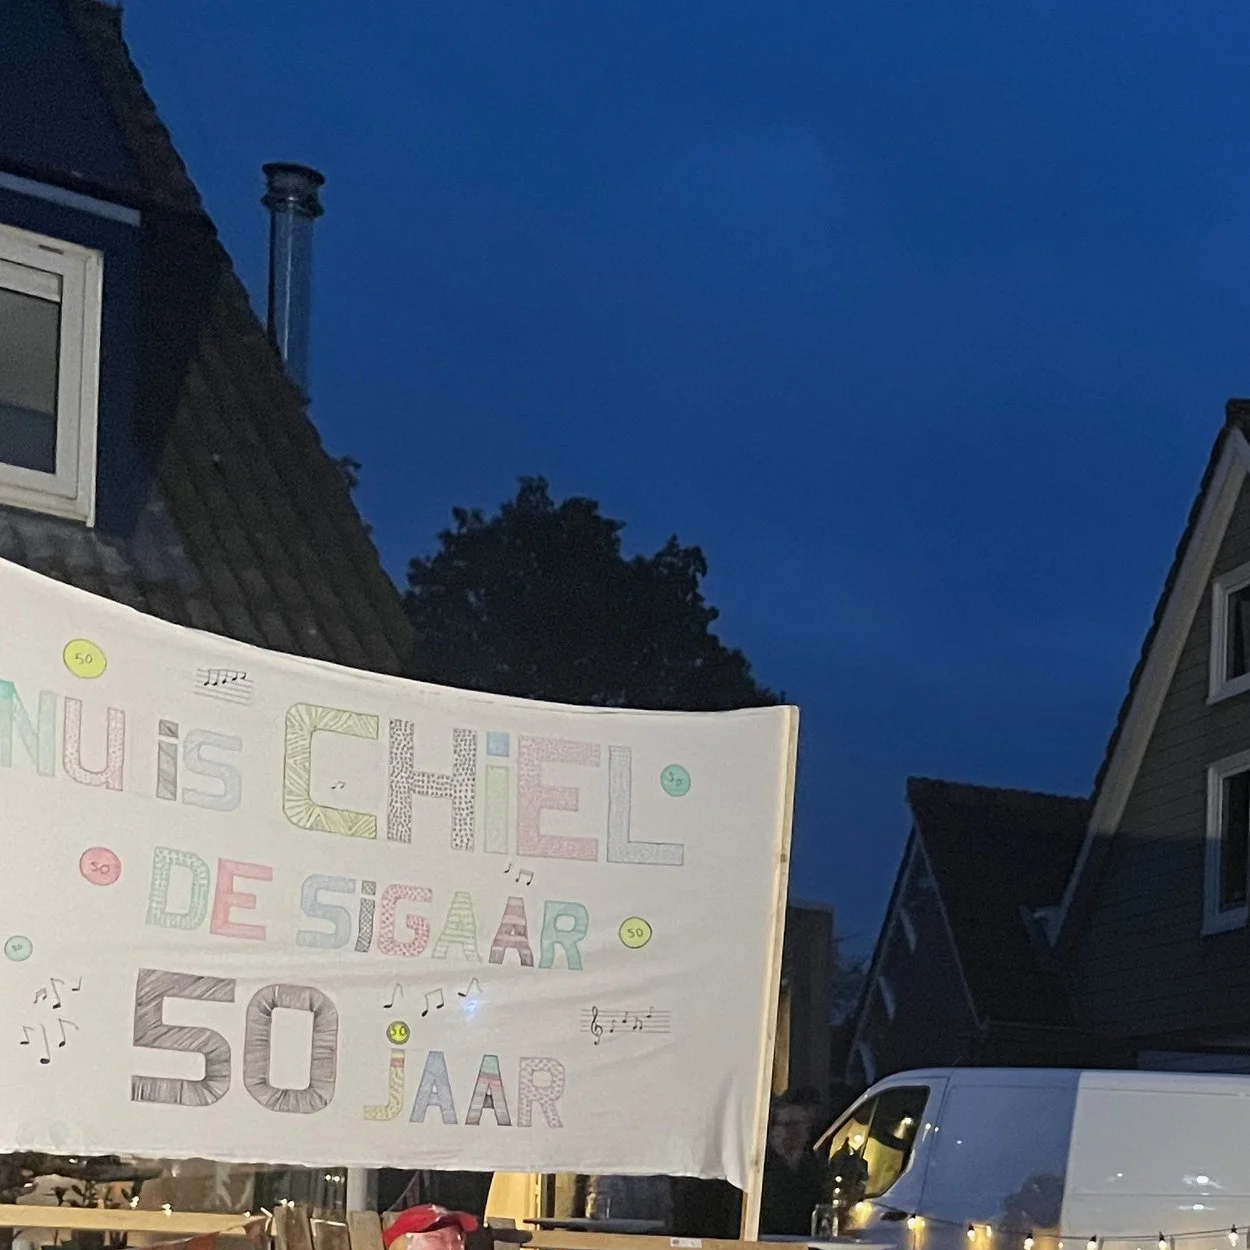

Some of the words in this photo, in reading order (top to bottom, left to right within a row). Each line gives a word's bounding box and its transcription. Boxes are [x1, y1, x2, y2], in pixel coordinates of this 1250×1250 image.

[146, 846, 273, 941] DE
[627, 928, 644, 938] 50
[131, 968, 339, 1114] 50
